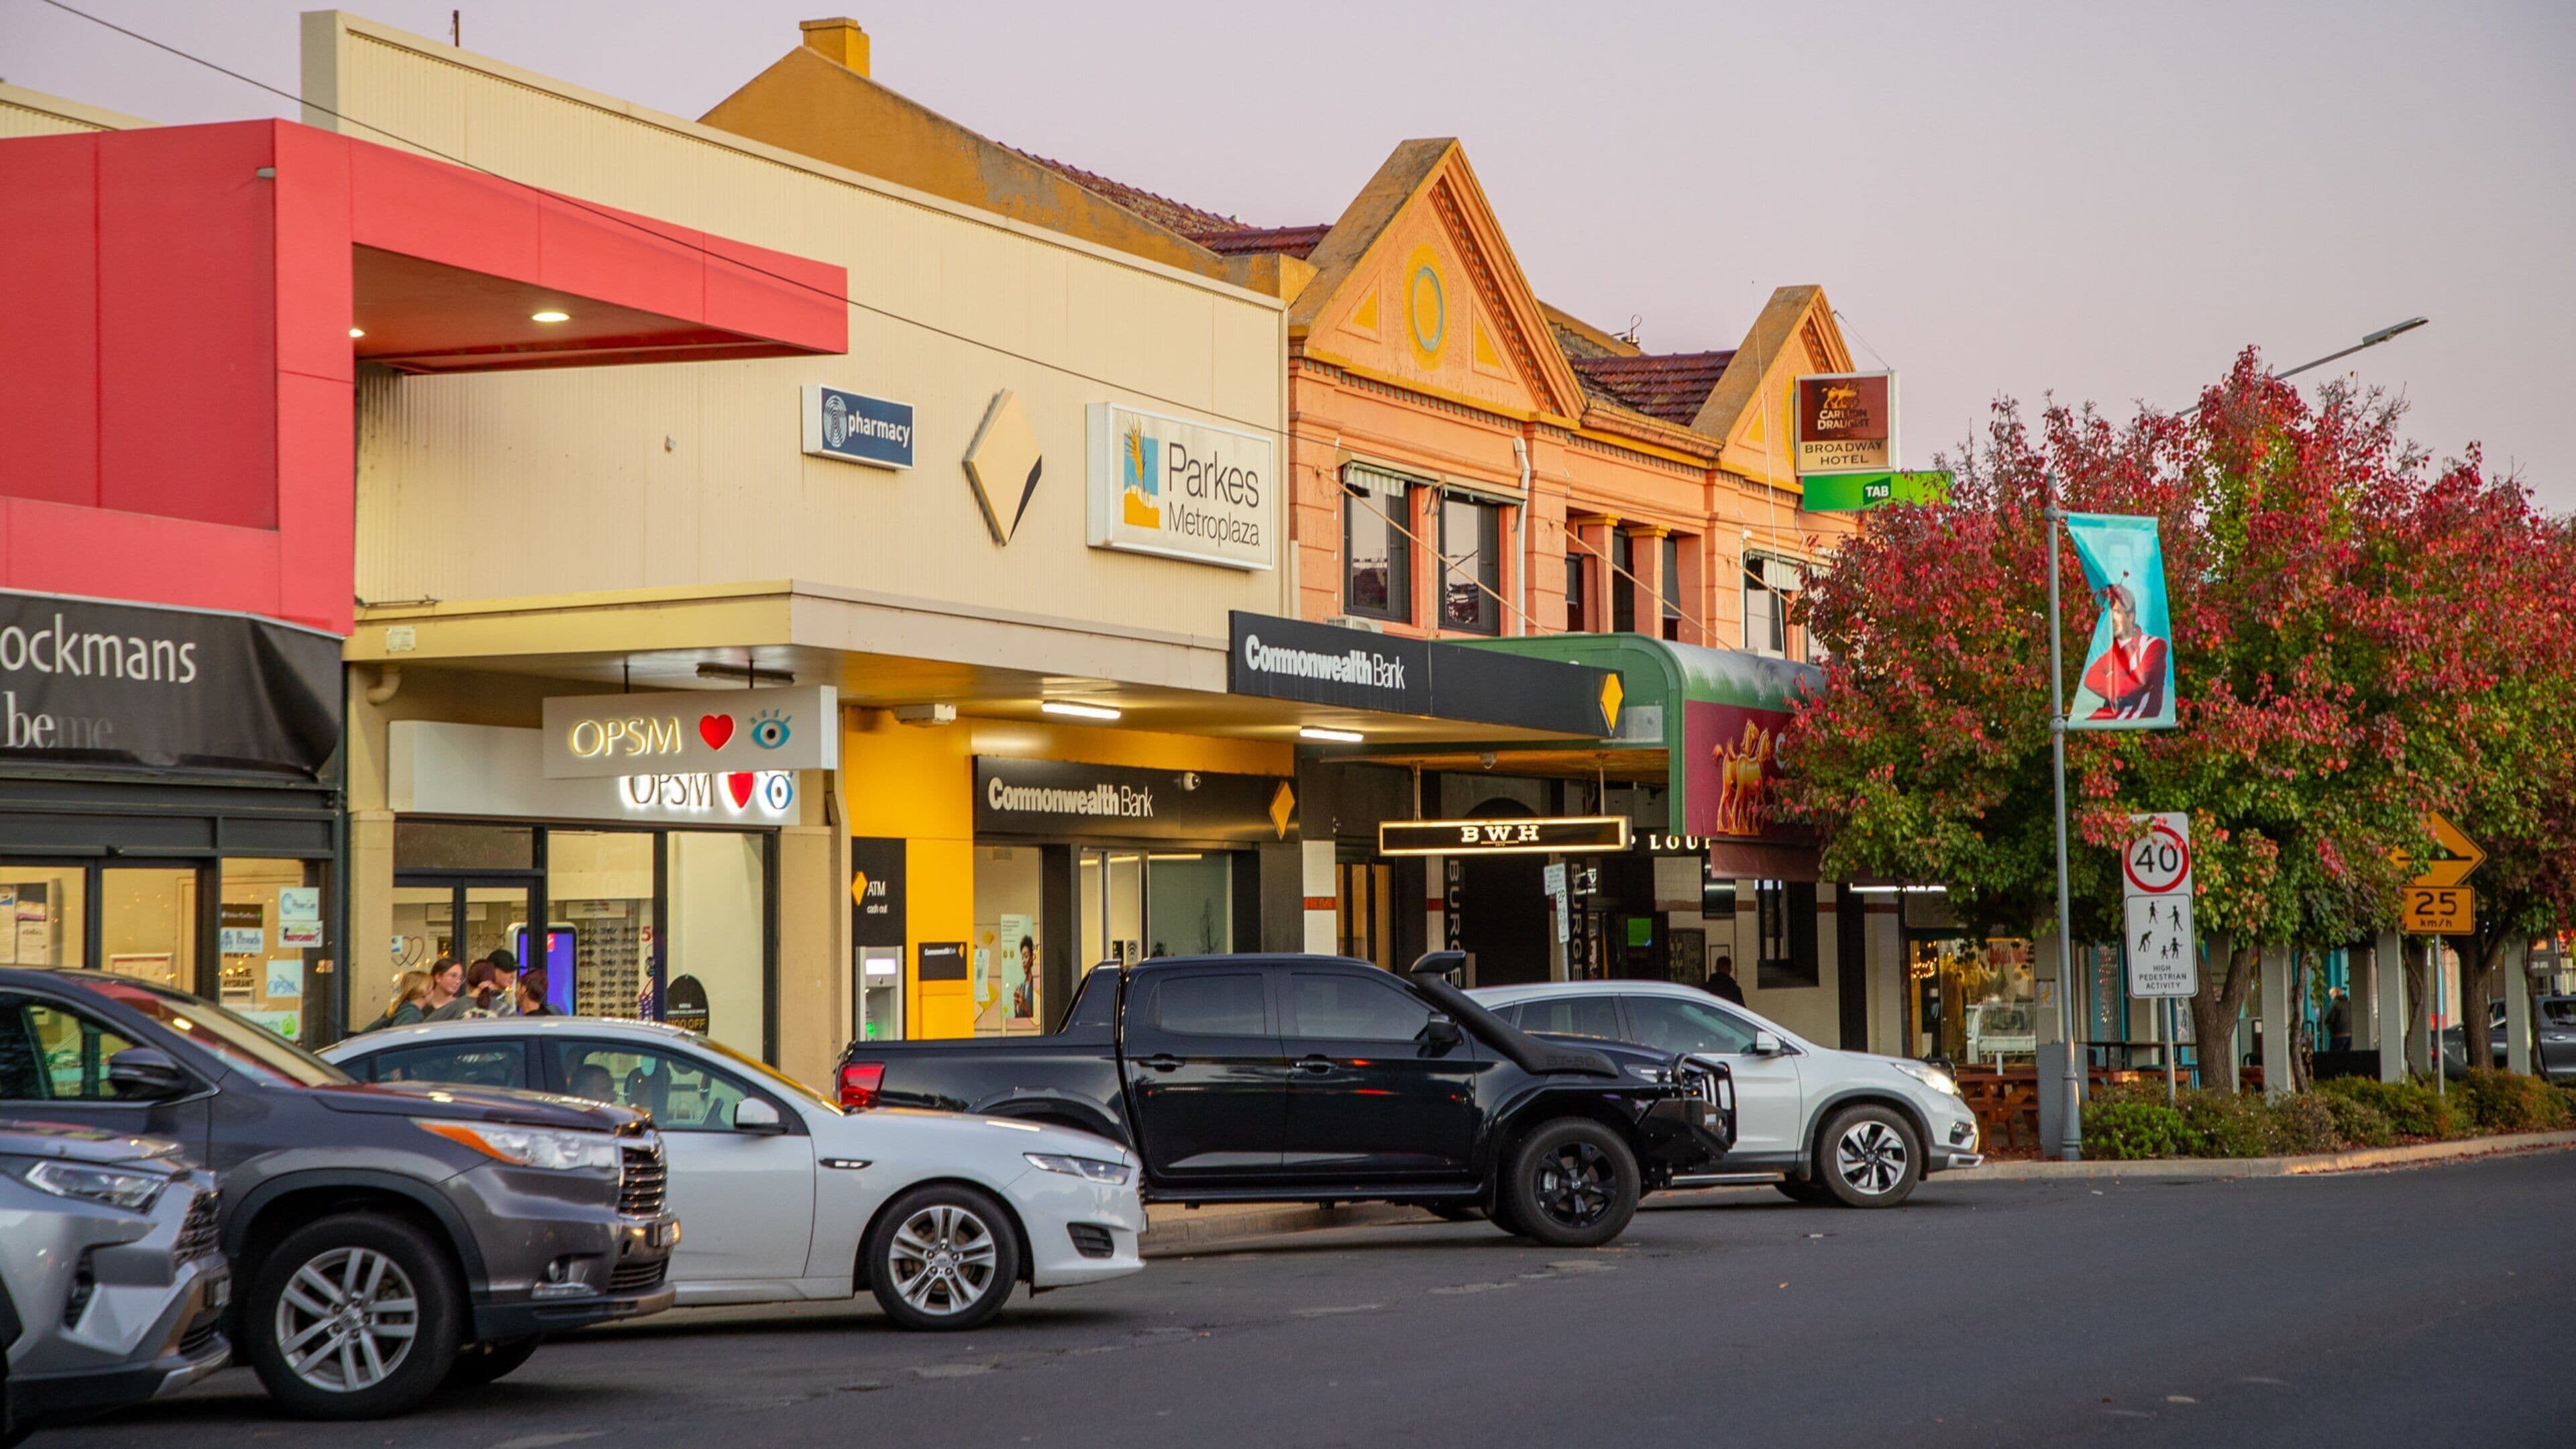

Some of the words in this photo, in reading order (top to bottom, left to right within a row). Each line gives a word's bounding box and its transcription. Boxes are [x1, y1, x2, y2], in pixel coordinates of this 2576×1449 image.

[1819, 409, 1868, 419] CARLTON
[847, 411, 910, 447] pharmacy
[1817, 419, 1869, 431] DRAUGHT
[1805, 441, 1883, 453] BROADWAY
[1820, 455, 1869, 466] HOTEL
[1169, 441, 1260, 508] Parkes
[1865, 485, 1889, 498] TAB
[1169, 501, 1260, 547] Metroplaza
[0, 613, 197, 683] ockmans
[570, 716, 682, 757] OPSM
[628, 773, 714, 808] OPSM
[1461, 824, 1540, 843] BWH
[2135, 843, 2178, 873] 40
[867, 881, 885, 896] ATM
[867, 904, 878, 914] cash
[879, 904, 888, 914] out
[2415, 892, 2457, 916] 25
[2420, 918, 2453, 927] km/h
[2139, 973, 2187, 981] PEDESTRIAN
